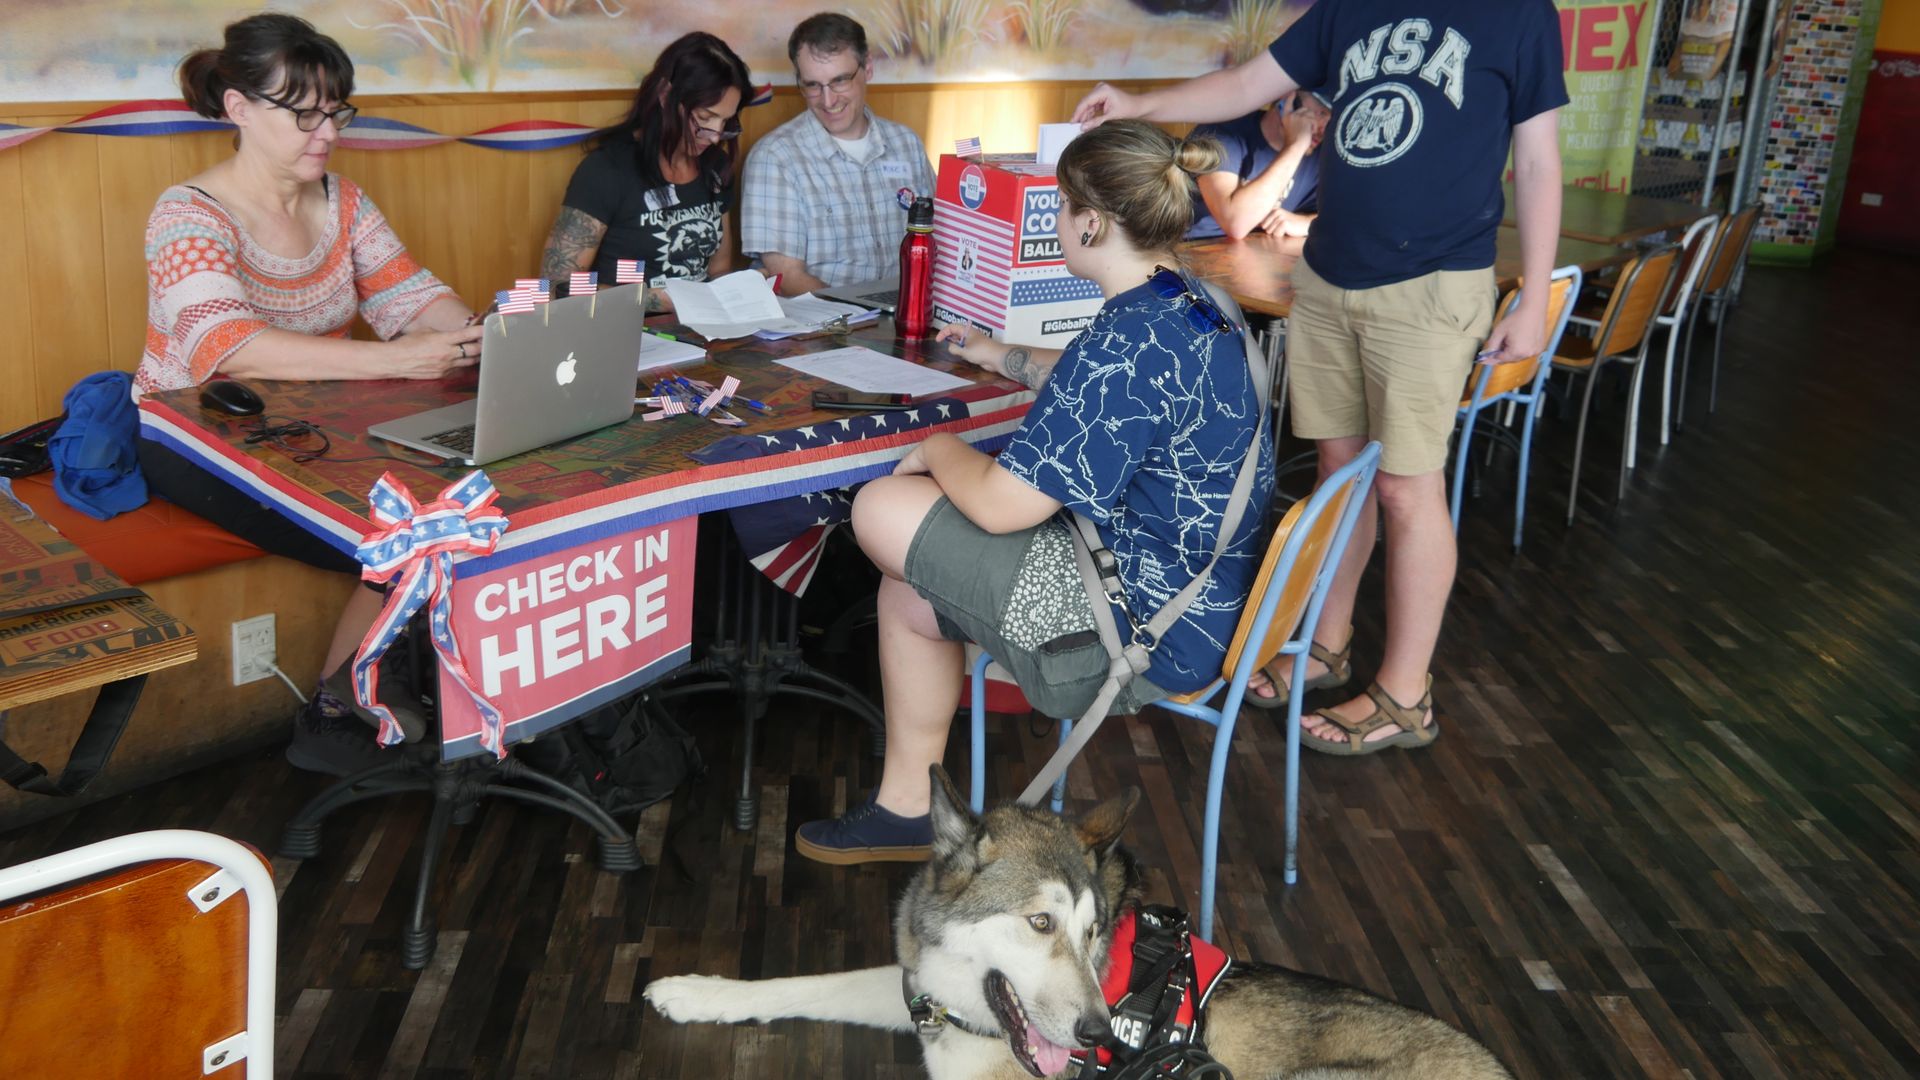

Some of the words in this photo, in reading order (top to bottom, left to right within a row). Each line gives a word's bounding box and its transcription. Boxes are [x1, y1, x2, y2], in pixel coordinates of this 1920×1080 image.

[1332, 18, 1471, 110] NSA
[1026, 212, 1060, 233] CO
[961, 237, 977, 249] VOTE
[1024, 241, 1065, 257] BALL
[474, 545, 624, 622] CHECK
[634, 529, 669, 574] IN
[1137, 579, 1170, 601] Mexicali
[23, 619, 121, 651] FOOD
[480, 573, 668, 698] HERE
